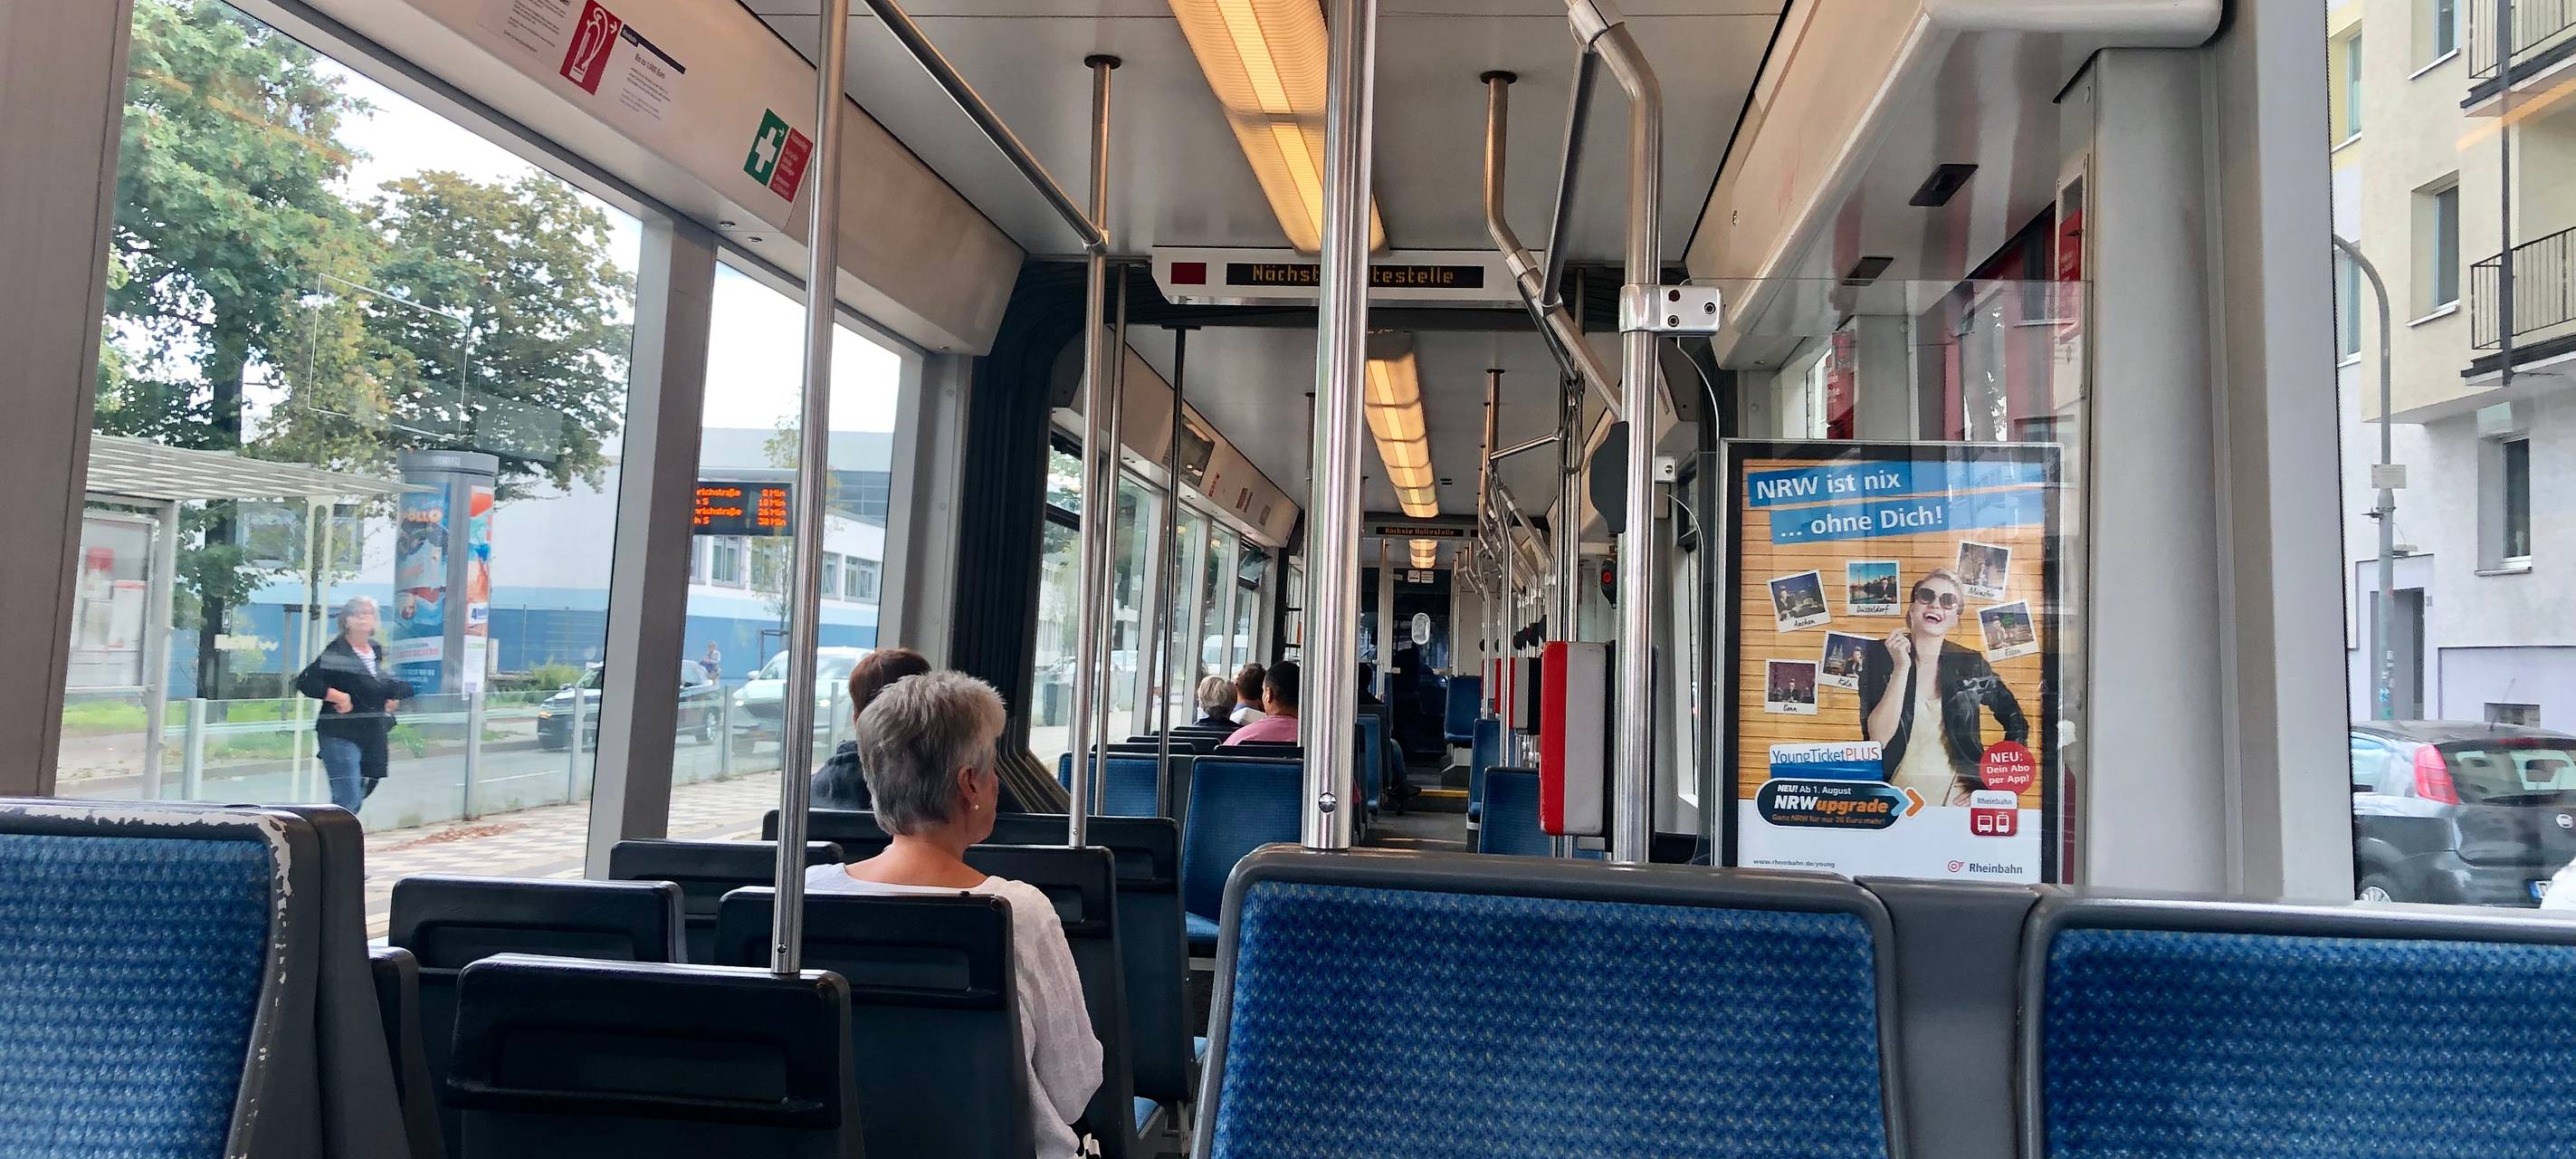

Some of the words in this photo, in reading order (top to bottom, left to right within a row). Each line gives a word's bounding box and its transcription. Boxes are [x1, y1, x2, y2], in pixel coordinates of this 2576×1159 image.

[1253, 263, 1319, 282] Nächst
[1372, 265, 1454, 283] testelle
[1756, 475, 1818, 500] NRW
[1827, 474, 1856, 493] ist
[1864, 469, 1901, 491] nix
[770, 508, 786, 516] Min
[1811, 513, 1872, 534] ohne
[1881, 505, 1942, 529] Dich!
[1793, 618, 1816, 627] Aachen
[1783, 704, 1798, 713] Bonn
[1772, 746, 1880, 763] YoungTicketPLUS
[1990, 752, 2023, 763] NEU:
[1986, 766, 2008, 774] Dein
[2010, 764, 2030, 772] Abo
[1989, 777, 2004, 786] per
[2007, 775, 2029, 784] App!
[1778, 784, 1798, 792] NEU!
[1822, 787, 1851, 796] August
[1774, 795, 1888, 814] NRWupgrade
[1753, 859, 1836, 868] www.rheinbahn.de/young
[1970, 863, 2023, 874] Rheinbahn
